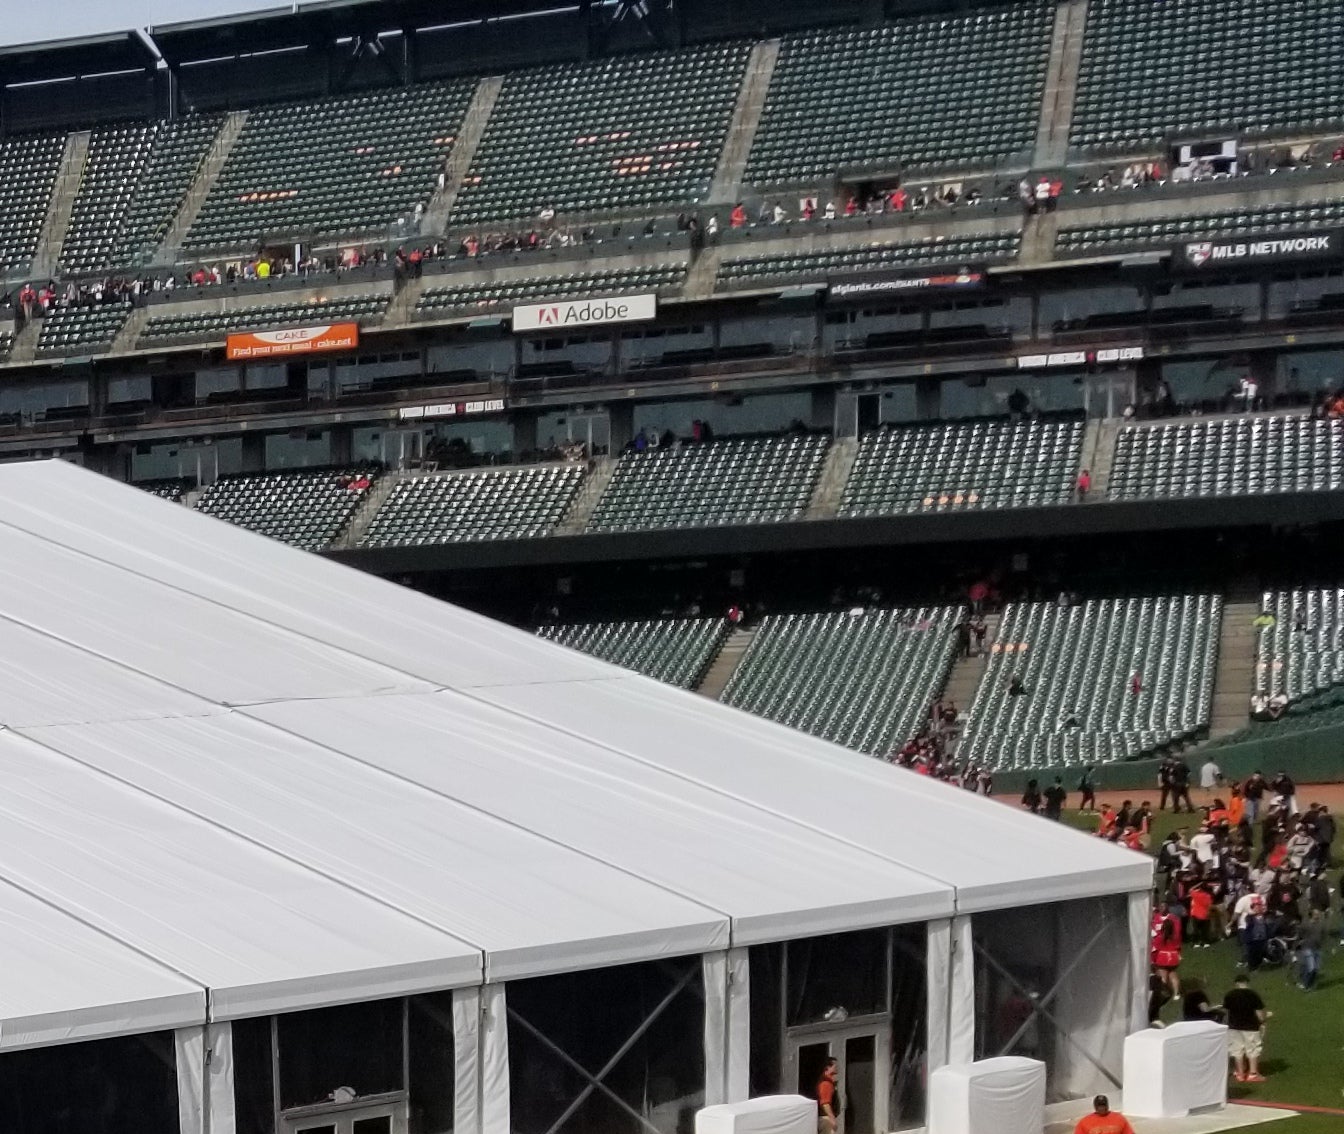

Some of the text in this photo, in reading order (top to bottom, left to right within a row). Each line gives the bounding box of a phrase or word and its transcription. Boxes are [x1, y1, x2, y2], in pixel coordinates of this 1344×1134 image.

[1213, 236, 1330, 258] MLB NETWORK
[564, 302, 628, 323] Adobe
[275, 330, 308, 341] CAKE
